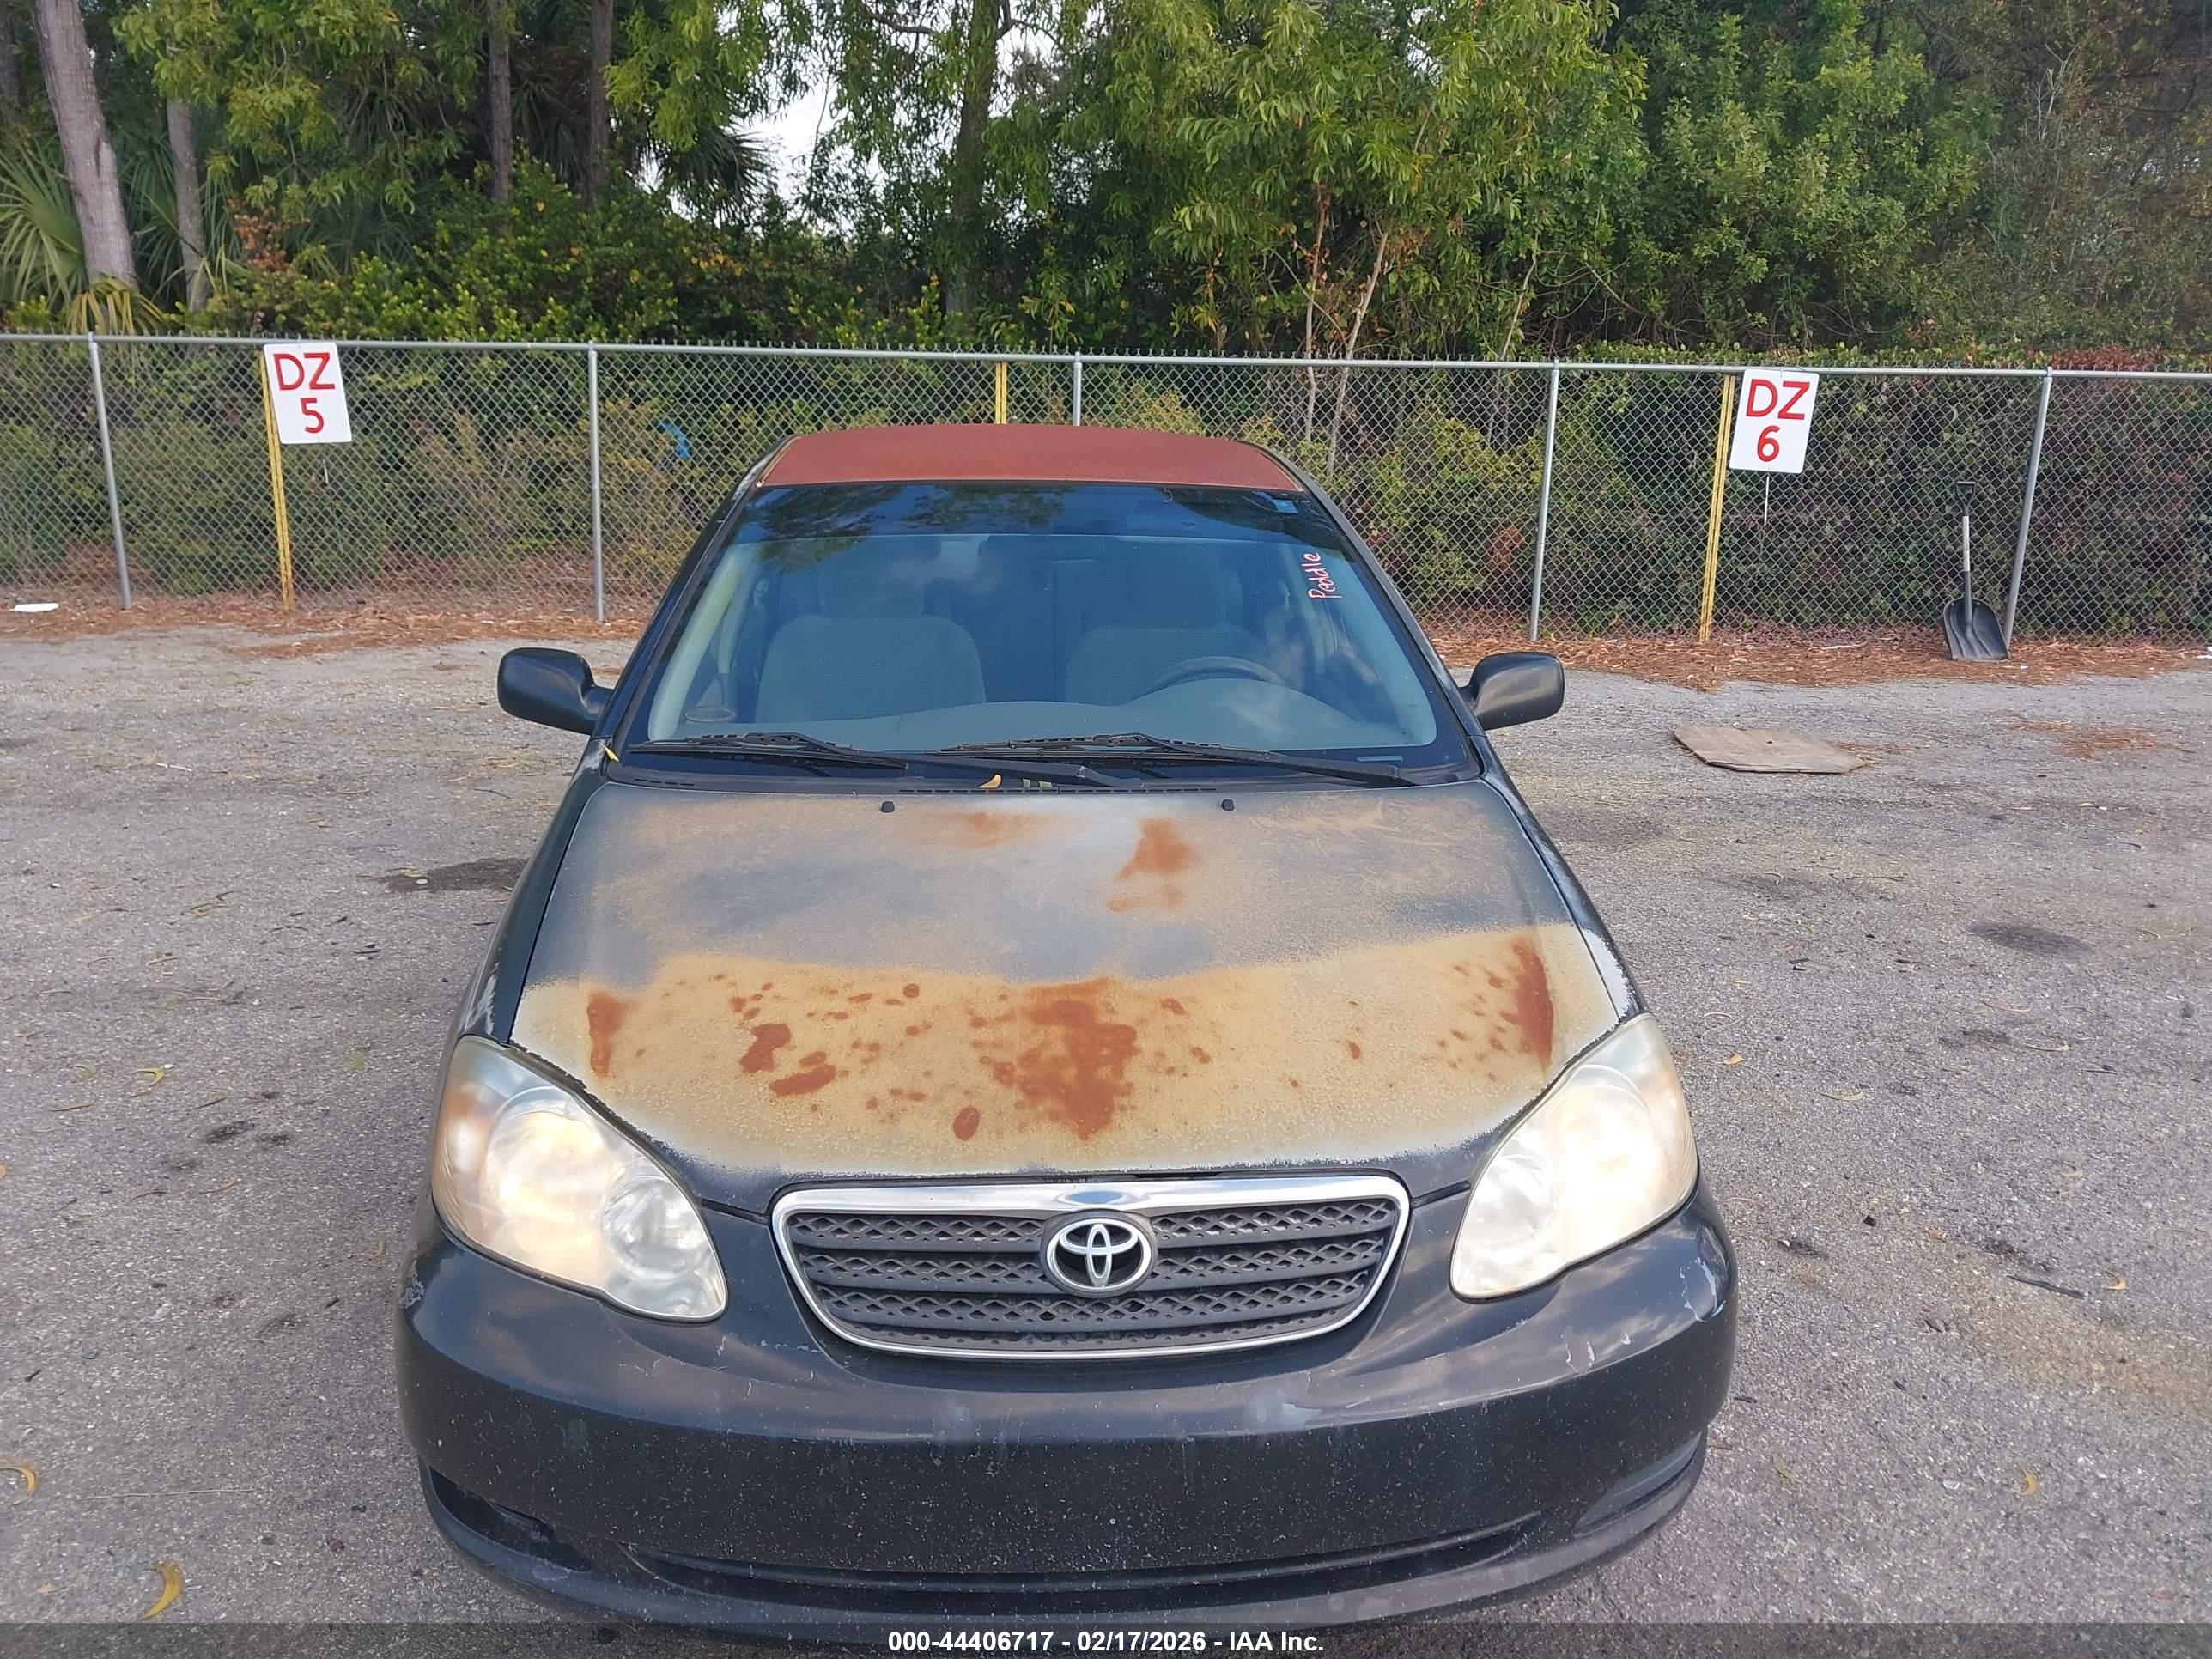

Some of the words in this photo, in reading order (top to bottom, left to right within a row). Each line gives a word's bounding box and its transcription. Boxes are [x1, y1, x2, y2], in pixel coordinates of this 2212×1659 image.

[273, 352, 336, 391] DZ
[300, 398, 325, 434] 5
[1746, 379, 1810, 420] DZ
[1757, 425, 1781, 462] 6
